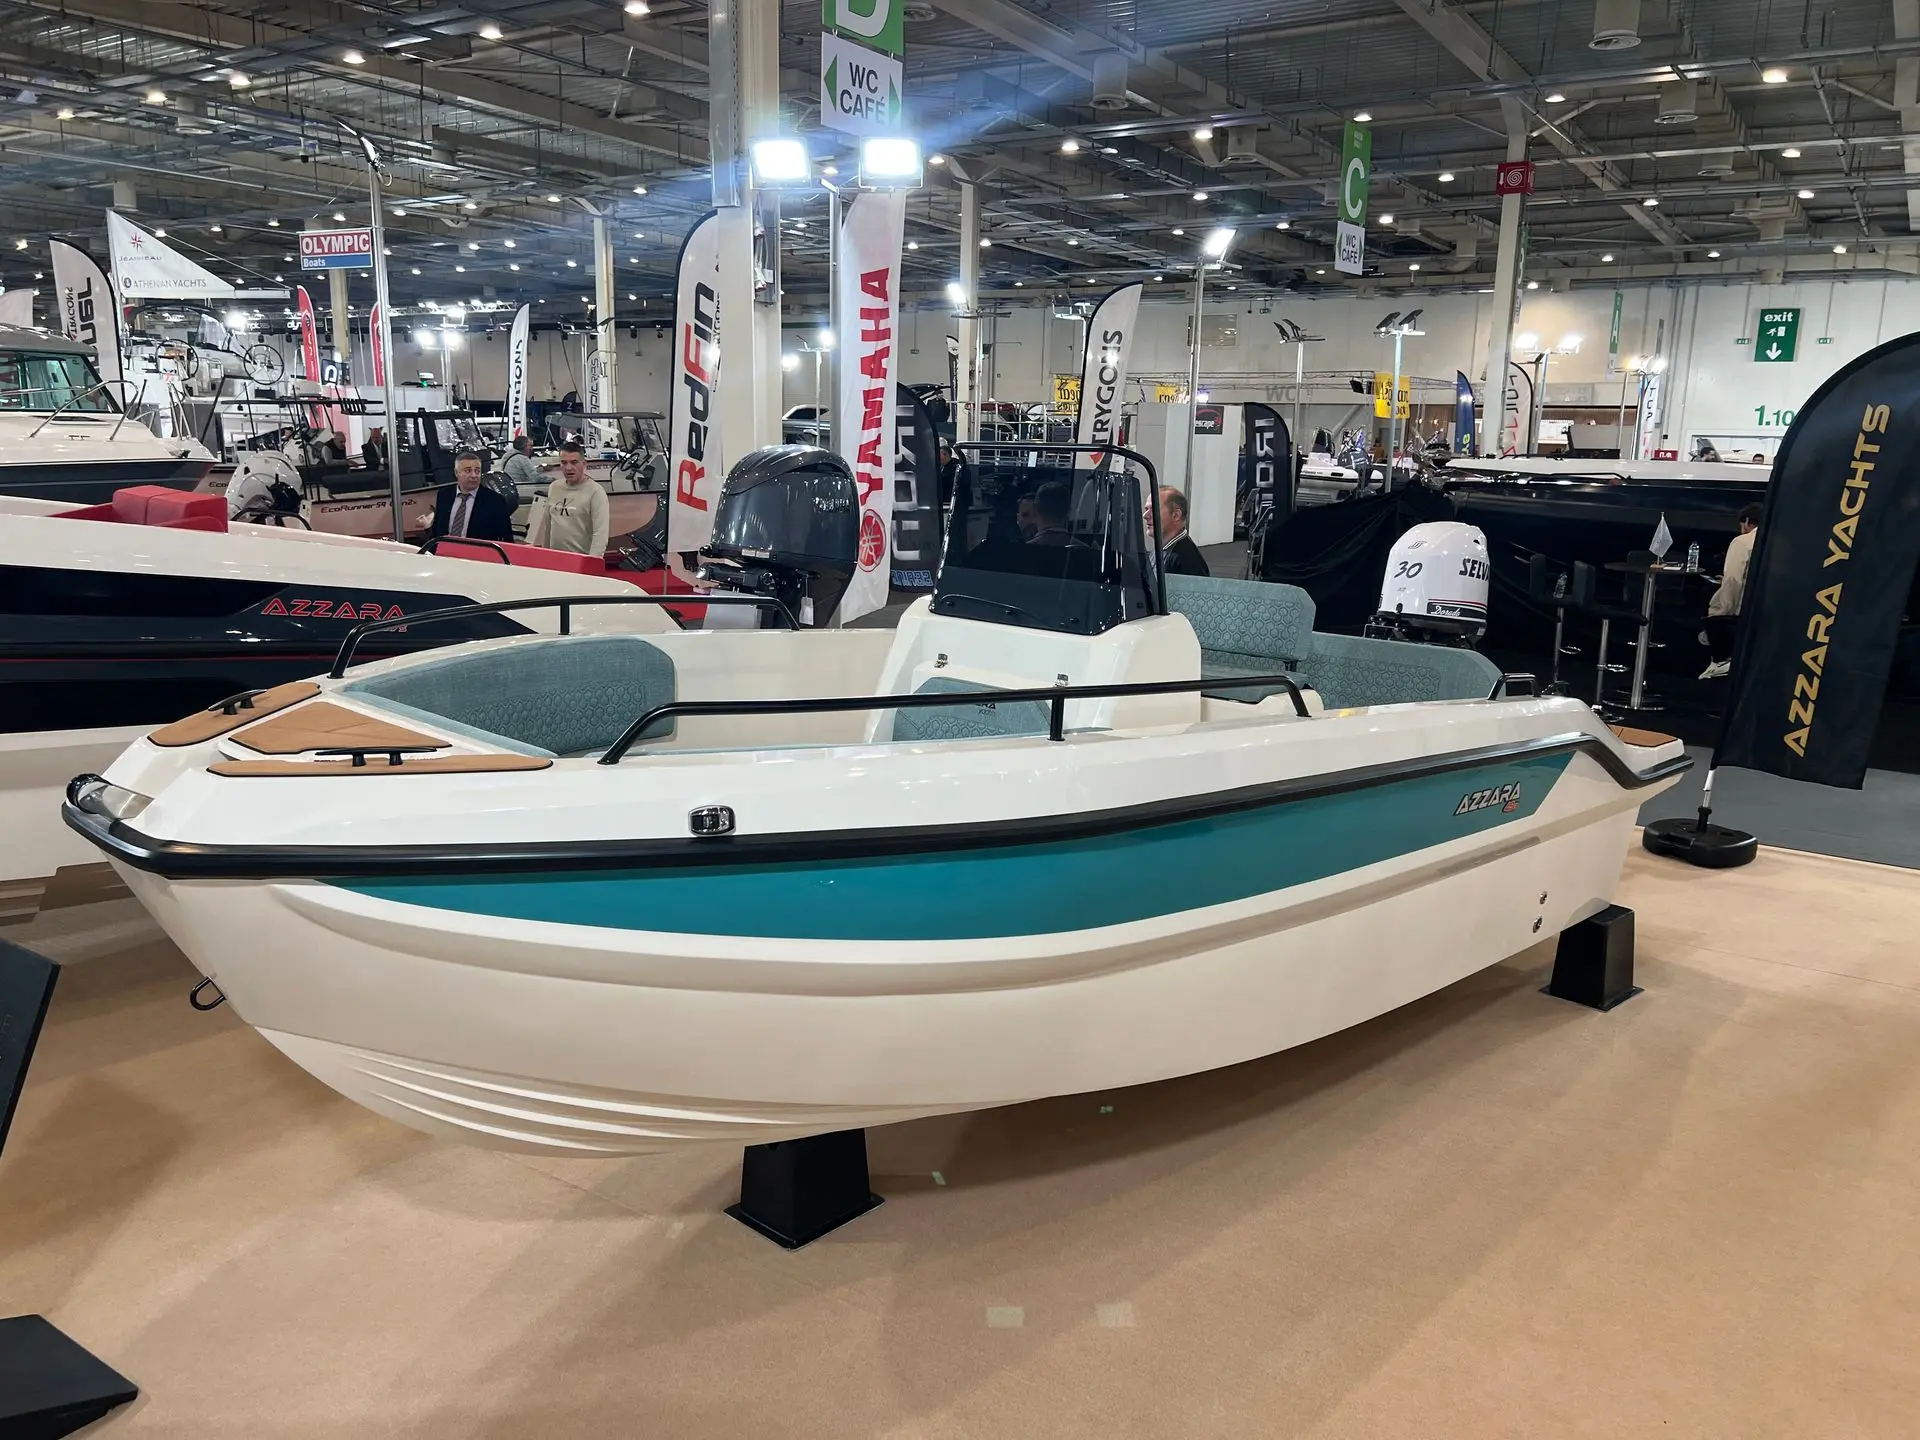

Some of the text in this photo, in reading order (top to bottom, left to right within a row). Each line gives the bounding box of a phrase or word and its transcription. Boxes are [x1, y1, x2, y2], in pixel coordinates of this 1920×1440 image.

[849, 62, 878, 94] WC
[840, 89, 886, 124] CAFÉ
[1345, 157, 1365, 219] C
[302, 234, 370, 254] OLYMPIC
[1346, 233, 1356, 248] WC
[303, 257, 326, 268] Boats
[172, 279, 207, 288] YACHTS
[1764, 311, 1793, 322] exit
[676, 281, 715, 512] RedFin
[856, 267, 891, 506] YAMAHA
[1754, 405, 1796, 426] 1.10
[1394, 561, 1422, 578] 30
[1783, 403, 1892, 757] AZZARA YACHTS
[261, 598, 404, 620] AZZARA
[1453, 781, 1520, 816] AZZARA
